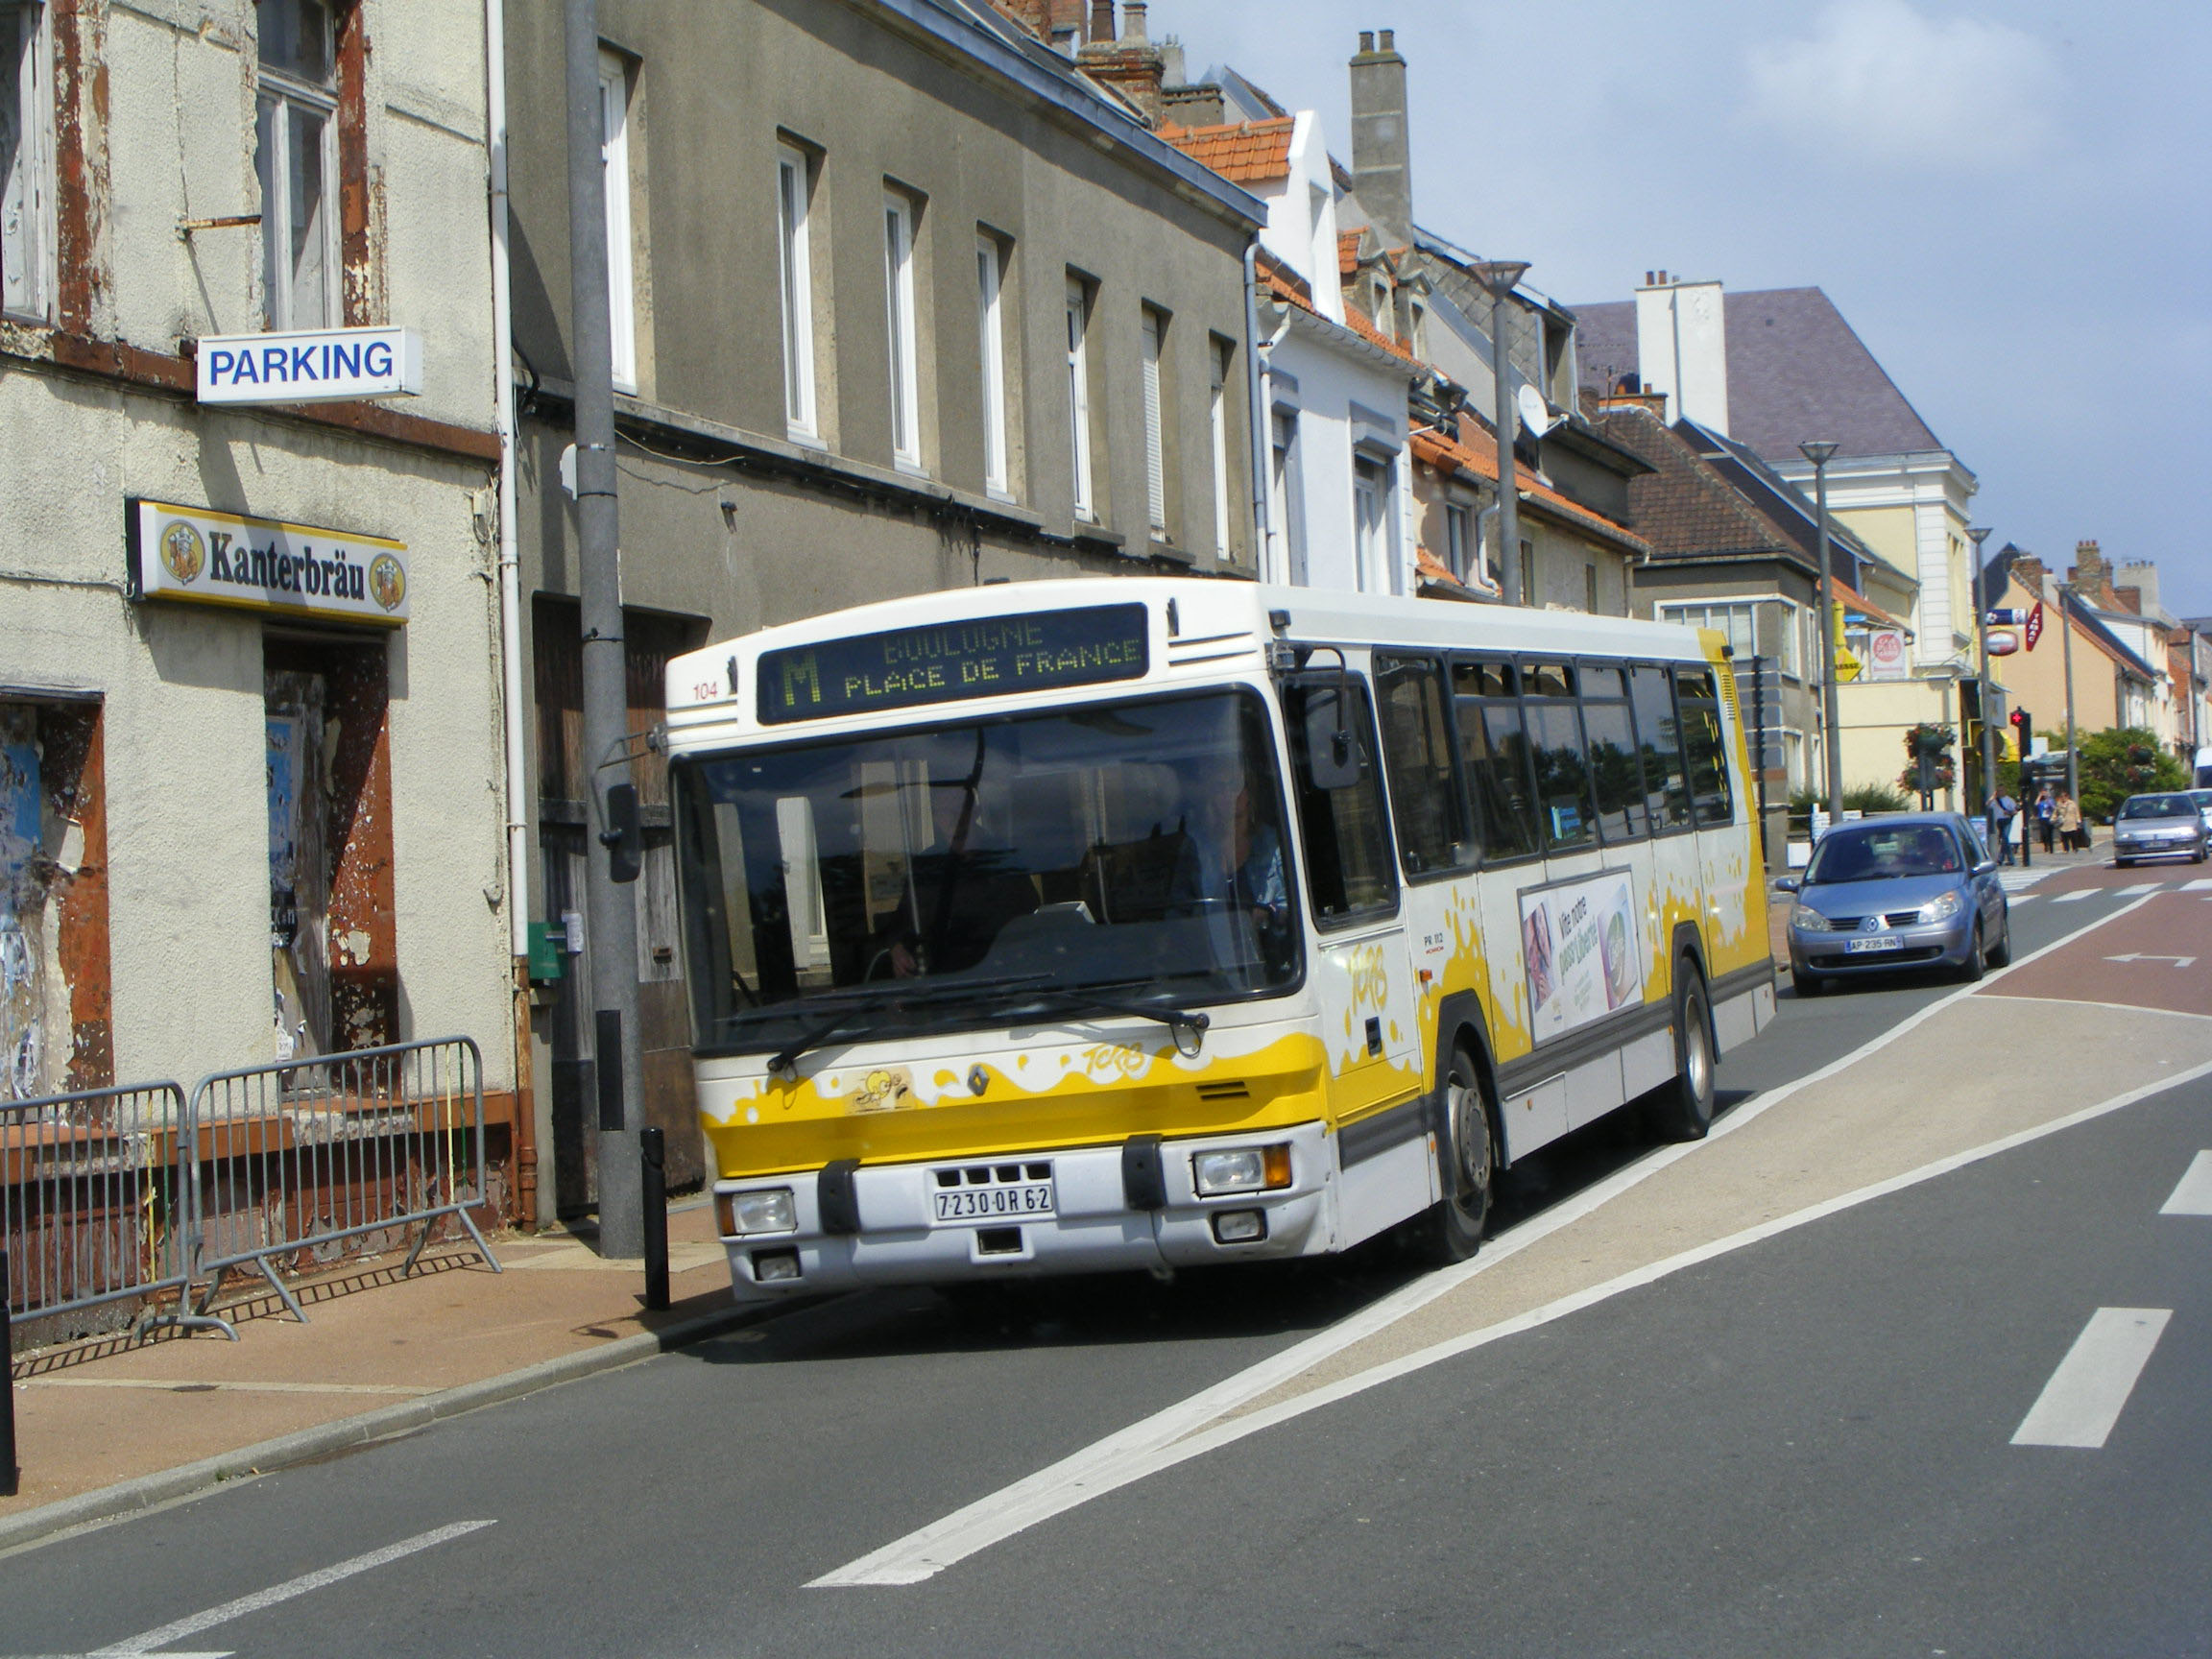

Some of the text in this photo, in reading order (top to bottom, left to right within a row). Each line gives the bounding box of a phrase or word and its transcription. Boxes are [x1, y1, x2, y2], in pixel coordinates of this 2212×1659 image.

[210, 342, 393, 386] PARKING
[208, 531, 365, 600] Kanterbräu
[2027, 613, 2040, 642] TABAC
[781, 638, 1142, 707] M PLACE DE FRANCE
[692, 682, 719, 701] 104
[939, 1192, 989, 1216] 7230
[1025, 1187, 1048, 1210] 62
